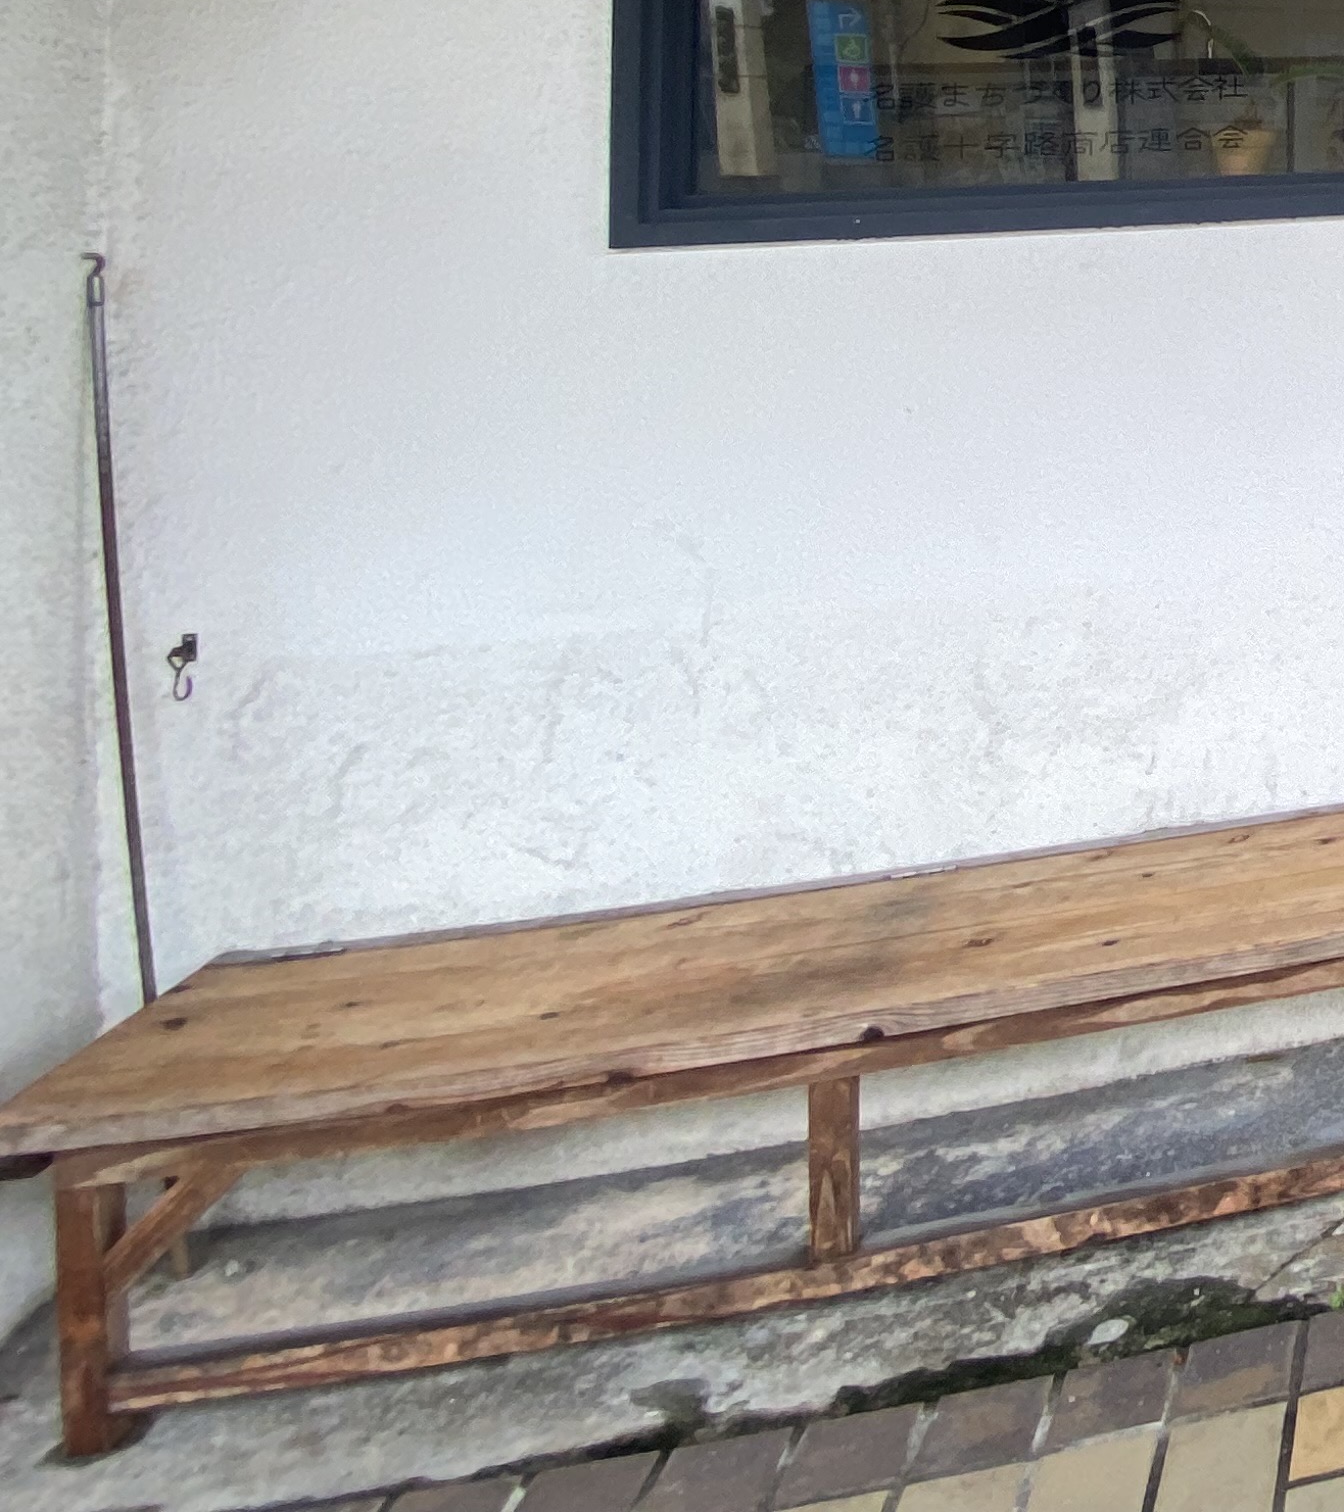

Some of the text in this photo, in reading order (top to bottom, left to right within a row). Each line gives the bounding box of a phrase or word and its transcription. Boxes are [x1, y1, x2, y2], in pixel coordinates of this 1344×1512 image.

[864, 76, 1249, 110] 名護まちづくり株式会社
[865, 125, 1249, 163] 名護十字路商店連合会
